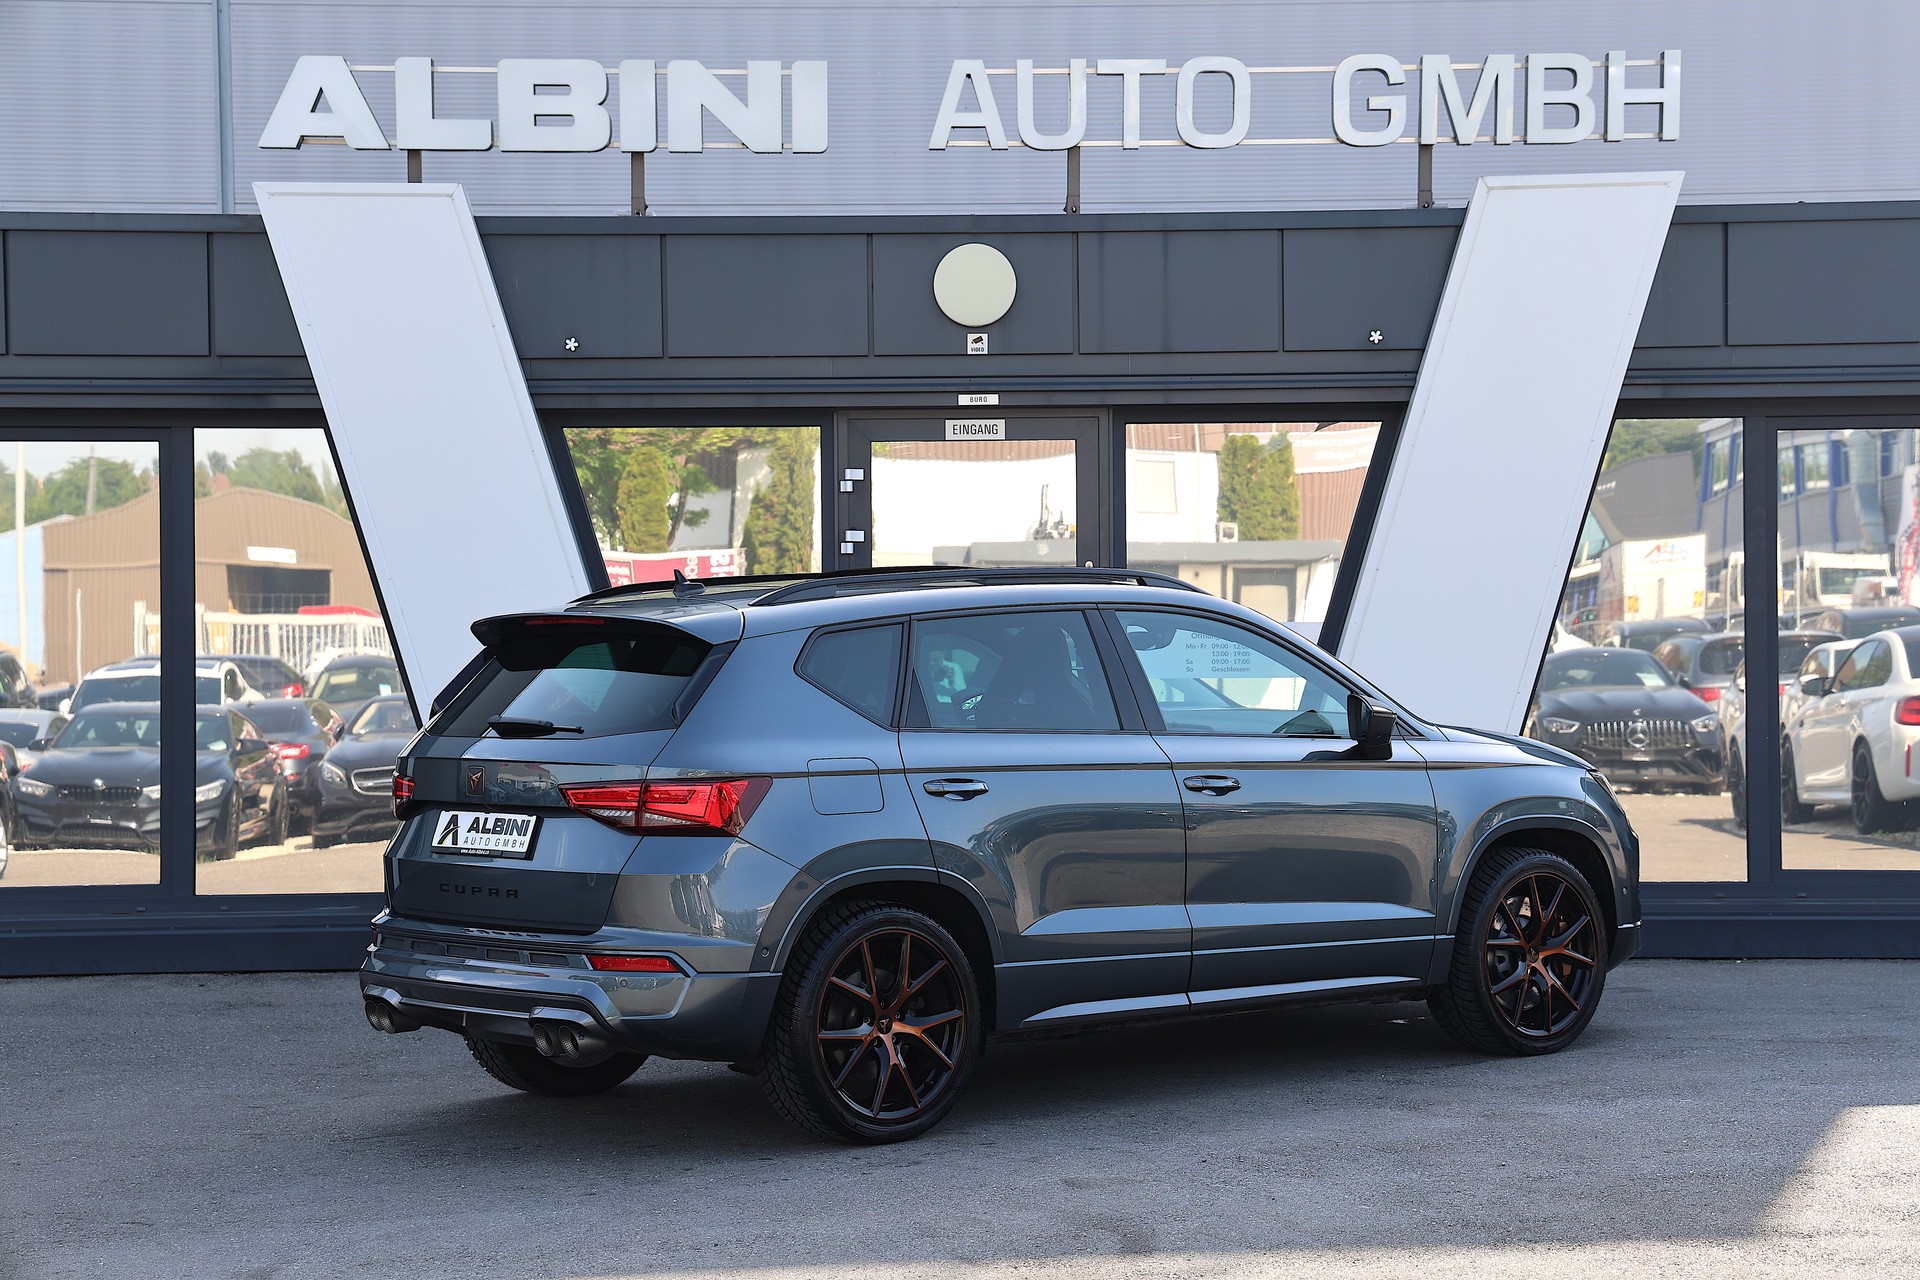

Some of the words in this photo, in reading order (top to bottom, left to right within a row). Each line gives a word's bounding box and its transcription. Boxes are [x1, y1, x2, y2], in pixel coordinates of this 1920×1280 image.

[257, 55, 829, 153] ALBINI
[928, 56, 1252, 151] AUTO
[1331, 49, 1683, 148] GMBH
[952, 423, 999, 435] EINGANG
[467, 817, 531, 836] ALBINI
[463, 837, 490, 846] AUTO
[494, 838, 525, 848] GMBH
[439, 883, 519, 899] CUPRA
